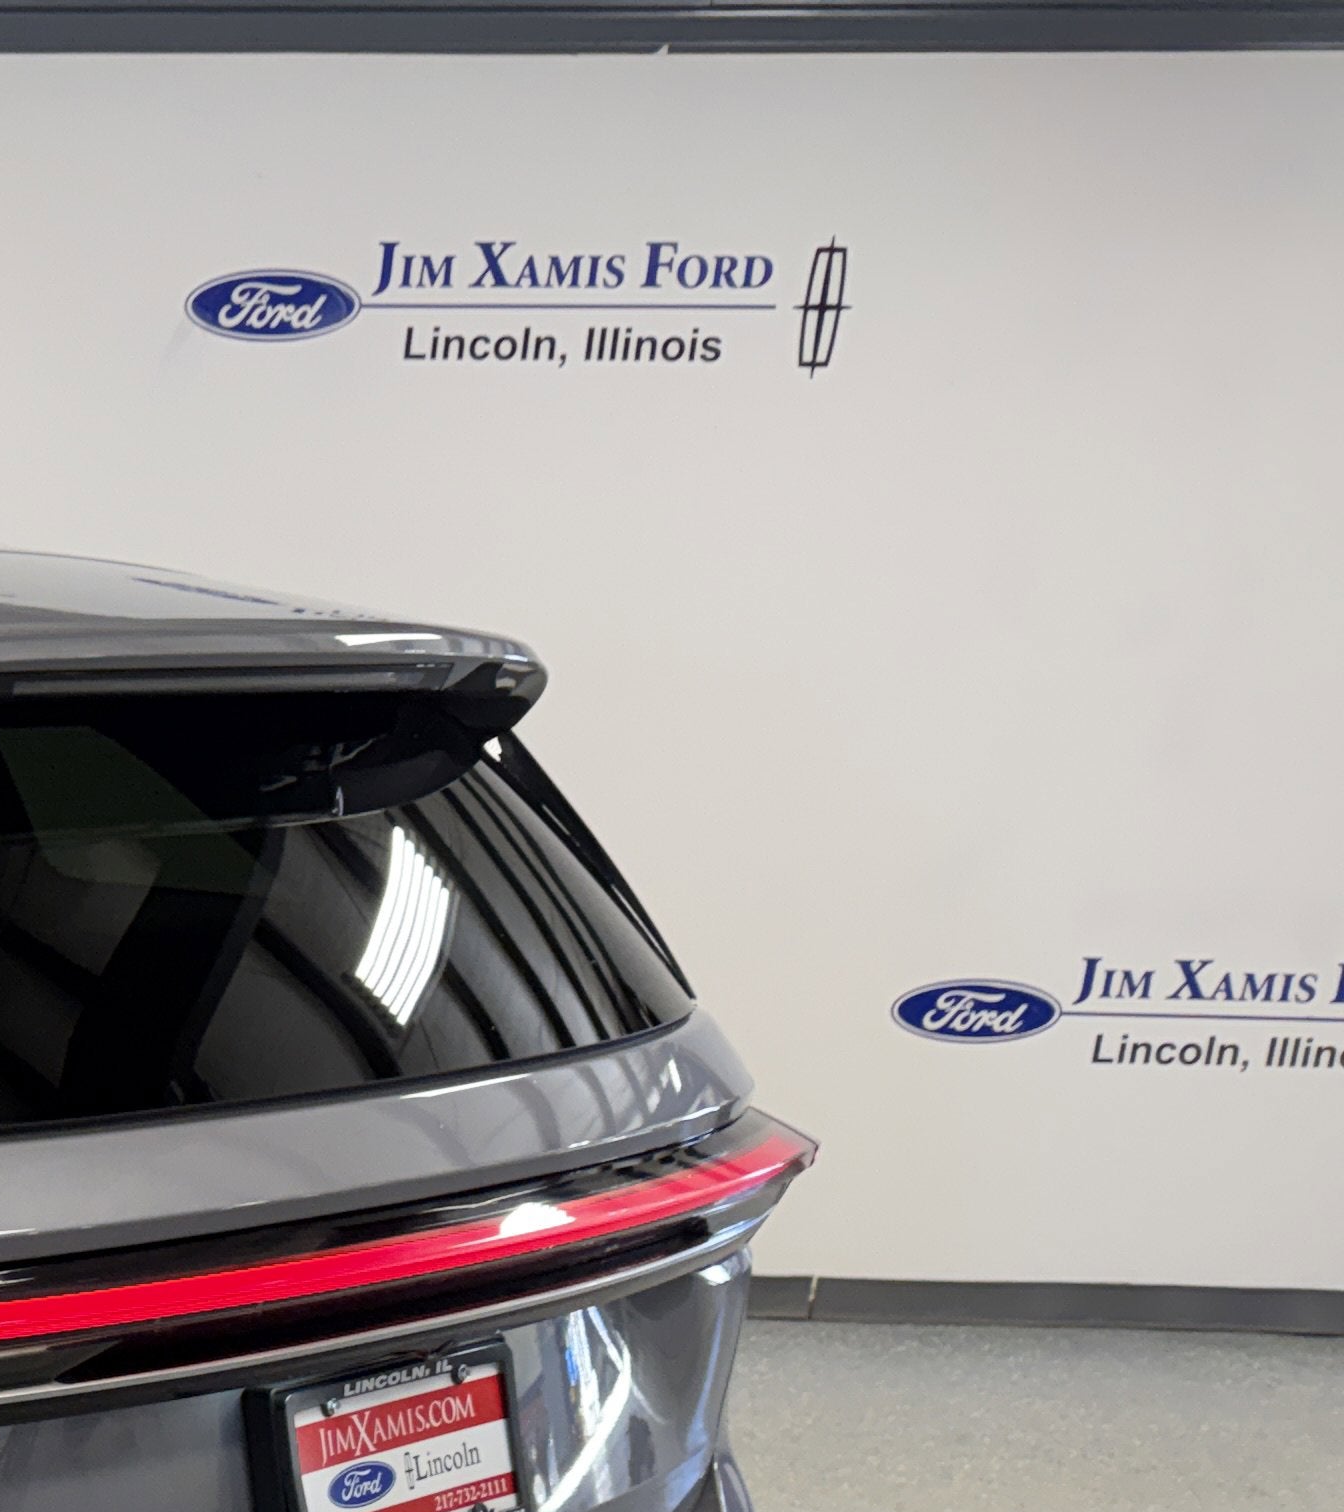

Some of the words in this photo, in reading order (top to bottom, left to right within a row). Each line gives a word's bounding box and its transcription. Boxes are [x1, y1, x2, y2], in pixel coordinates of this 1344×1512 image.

[371, 242, 455, 296] JIM
[468, 242, 626, 289] XAMIS
[640, 242, 773, 289] FORD
[216, 282, 323, 330] Ford
[403, 327, 567, 367] Lincoln,
[584, 327, 722, 363] Illinois
[1072, 957, 1154, 1005] JIM
[1165, 959, 1318, 1003] XAMIS
[922, 990, 1024, 1033] Ford
[1091, 1034, 1250, 1072] Lincoln,
[1265, 1037, 1344, 1069] Illin
[435, 1359, 453, 1374] IL
[319, 1394, 475, 1466] JIMXAMIS.COM
[414, 1442, 481, 1481] Lincoln
[434, 1478, 508, 1511] 217-732-2111
